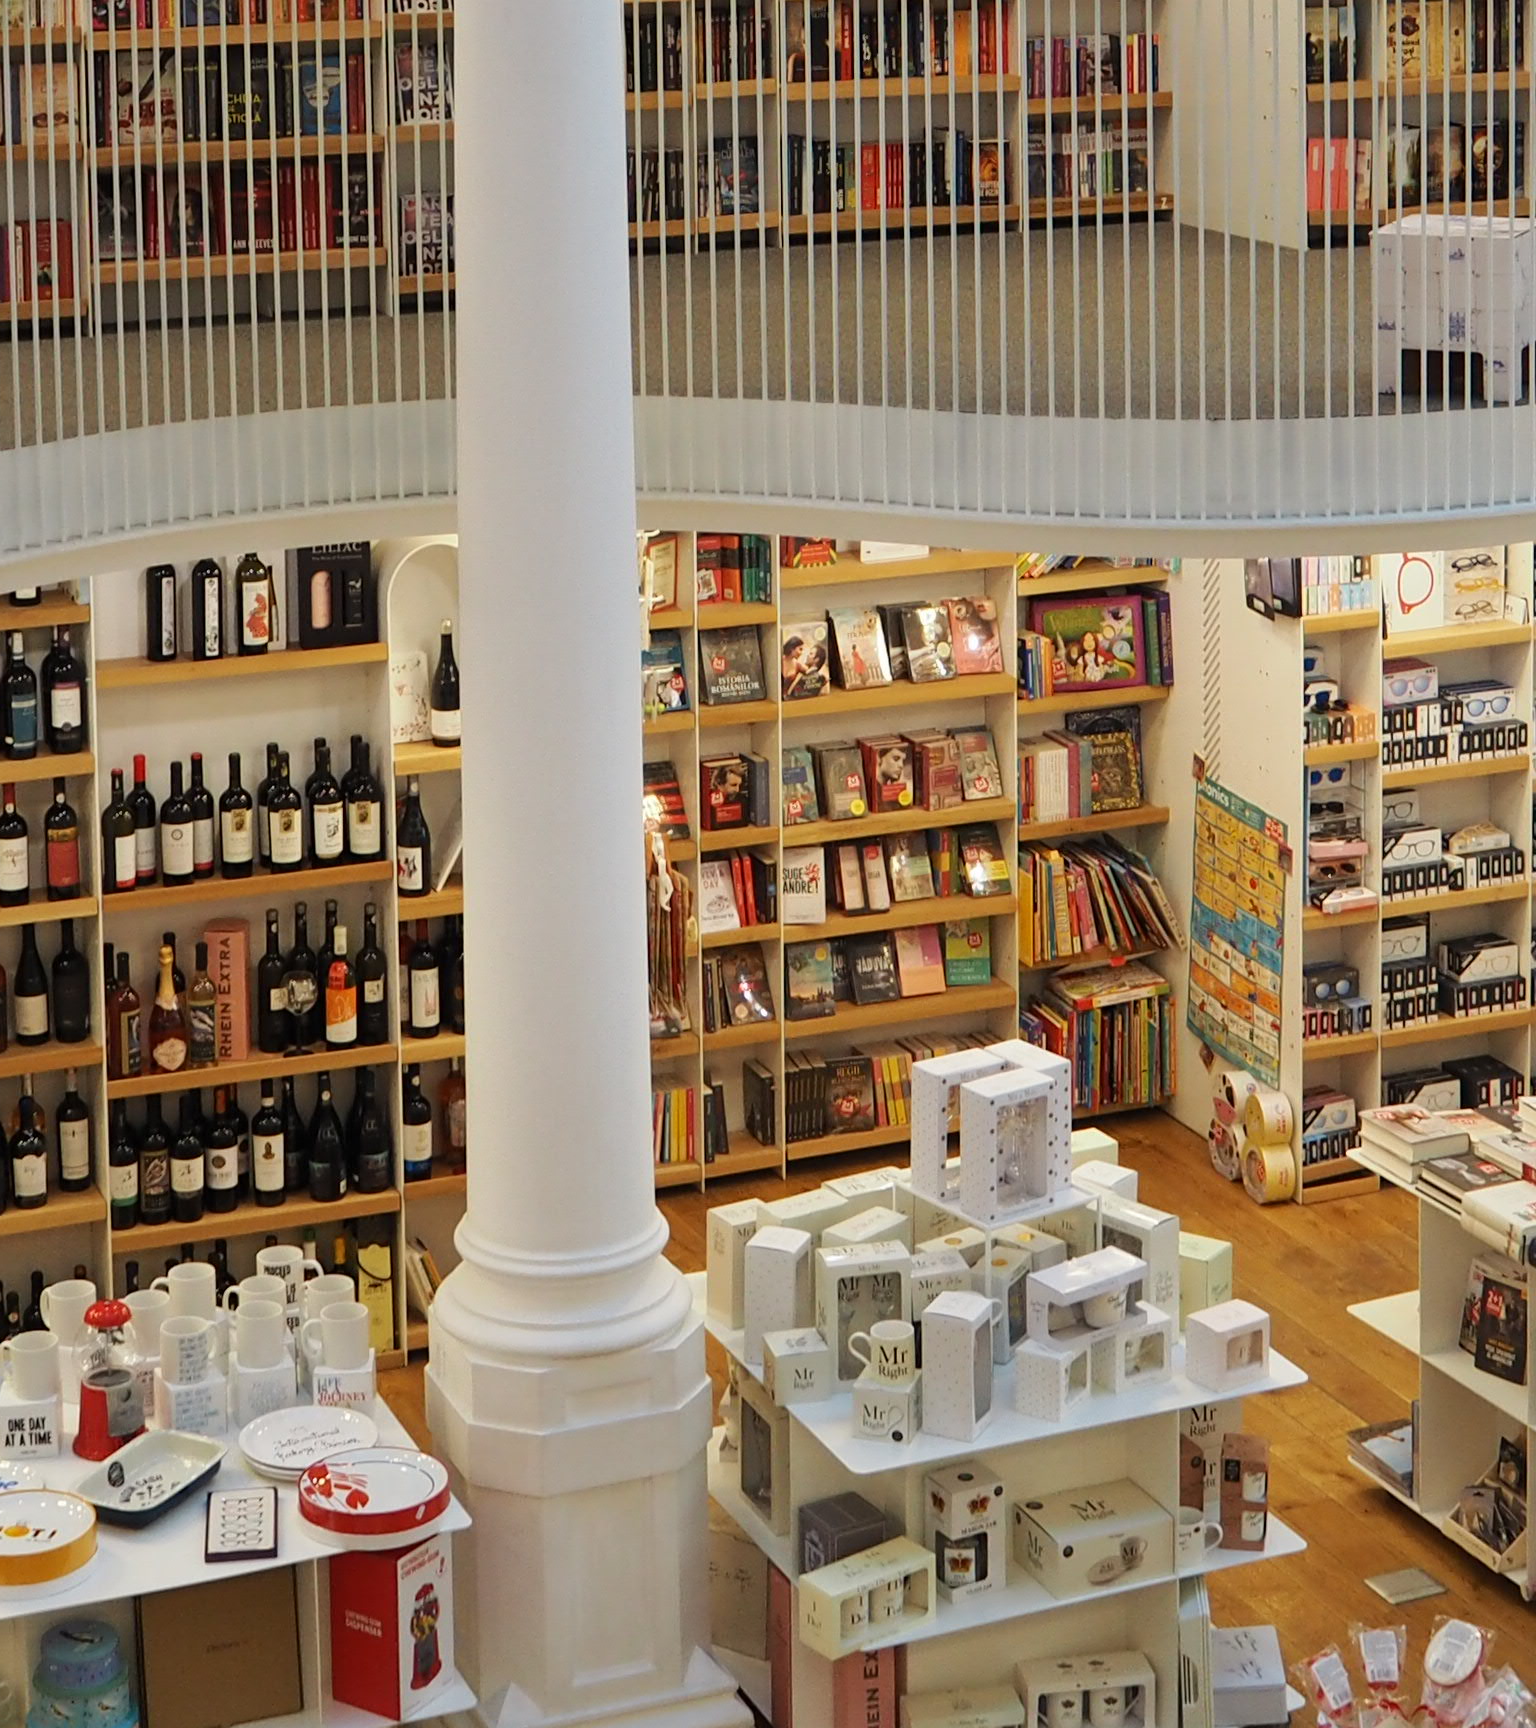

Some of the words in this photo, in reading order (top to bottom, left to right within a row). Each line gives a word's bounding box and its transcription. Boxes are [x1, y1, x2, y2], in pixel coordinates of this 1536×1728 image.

[718, 675, 751, 685] ISTORIA
[218, 937, 231, 995] EXTRA
[218, 1004, 232, 1058] RHEIN
[878, 1345, 909, 1366] Mr
[794, 1367, 815, 1381] Mr
[878, 1365, 909, 1382] Right
[862, 1403, 886, 1420] Mr
[1190, 1407, 1217, 1425] Mr
[8, 1418, 26, 1432] ONE
[29, 1416, 46, 1431] DAY
[1189, 1422, 1216, 1438] Right
[5, 1433, 16, 1447] AT
[19, 1433, 26, 1447] A
[29, 1431, 52, 1446] TIME
[1071, 1497, 1107, 1514] Mr
